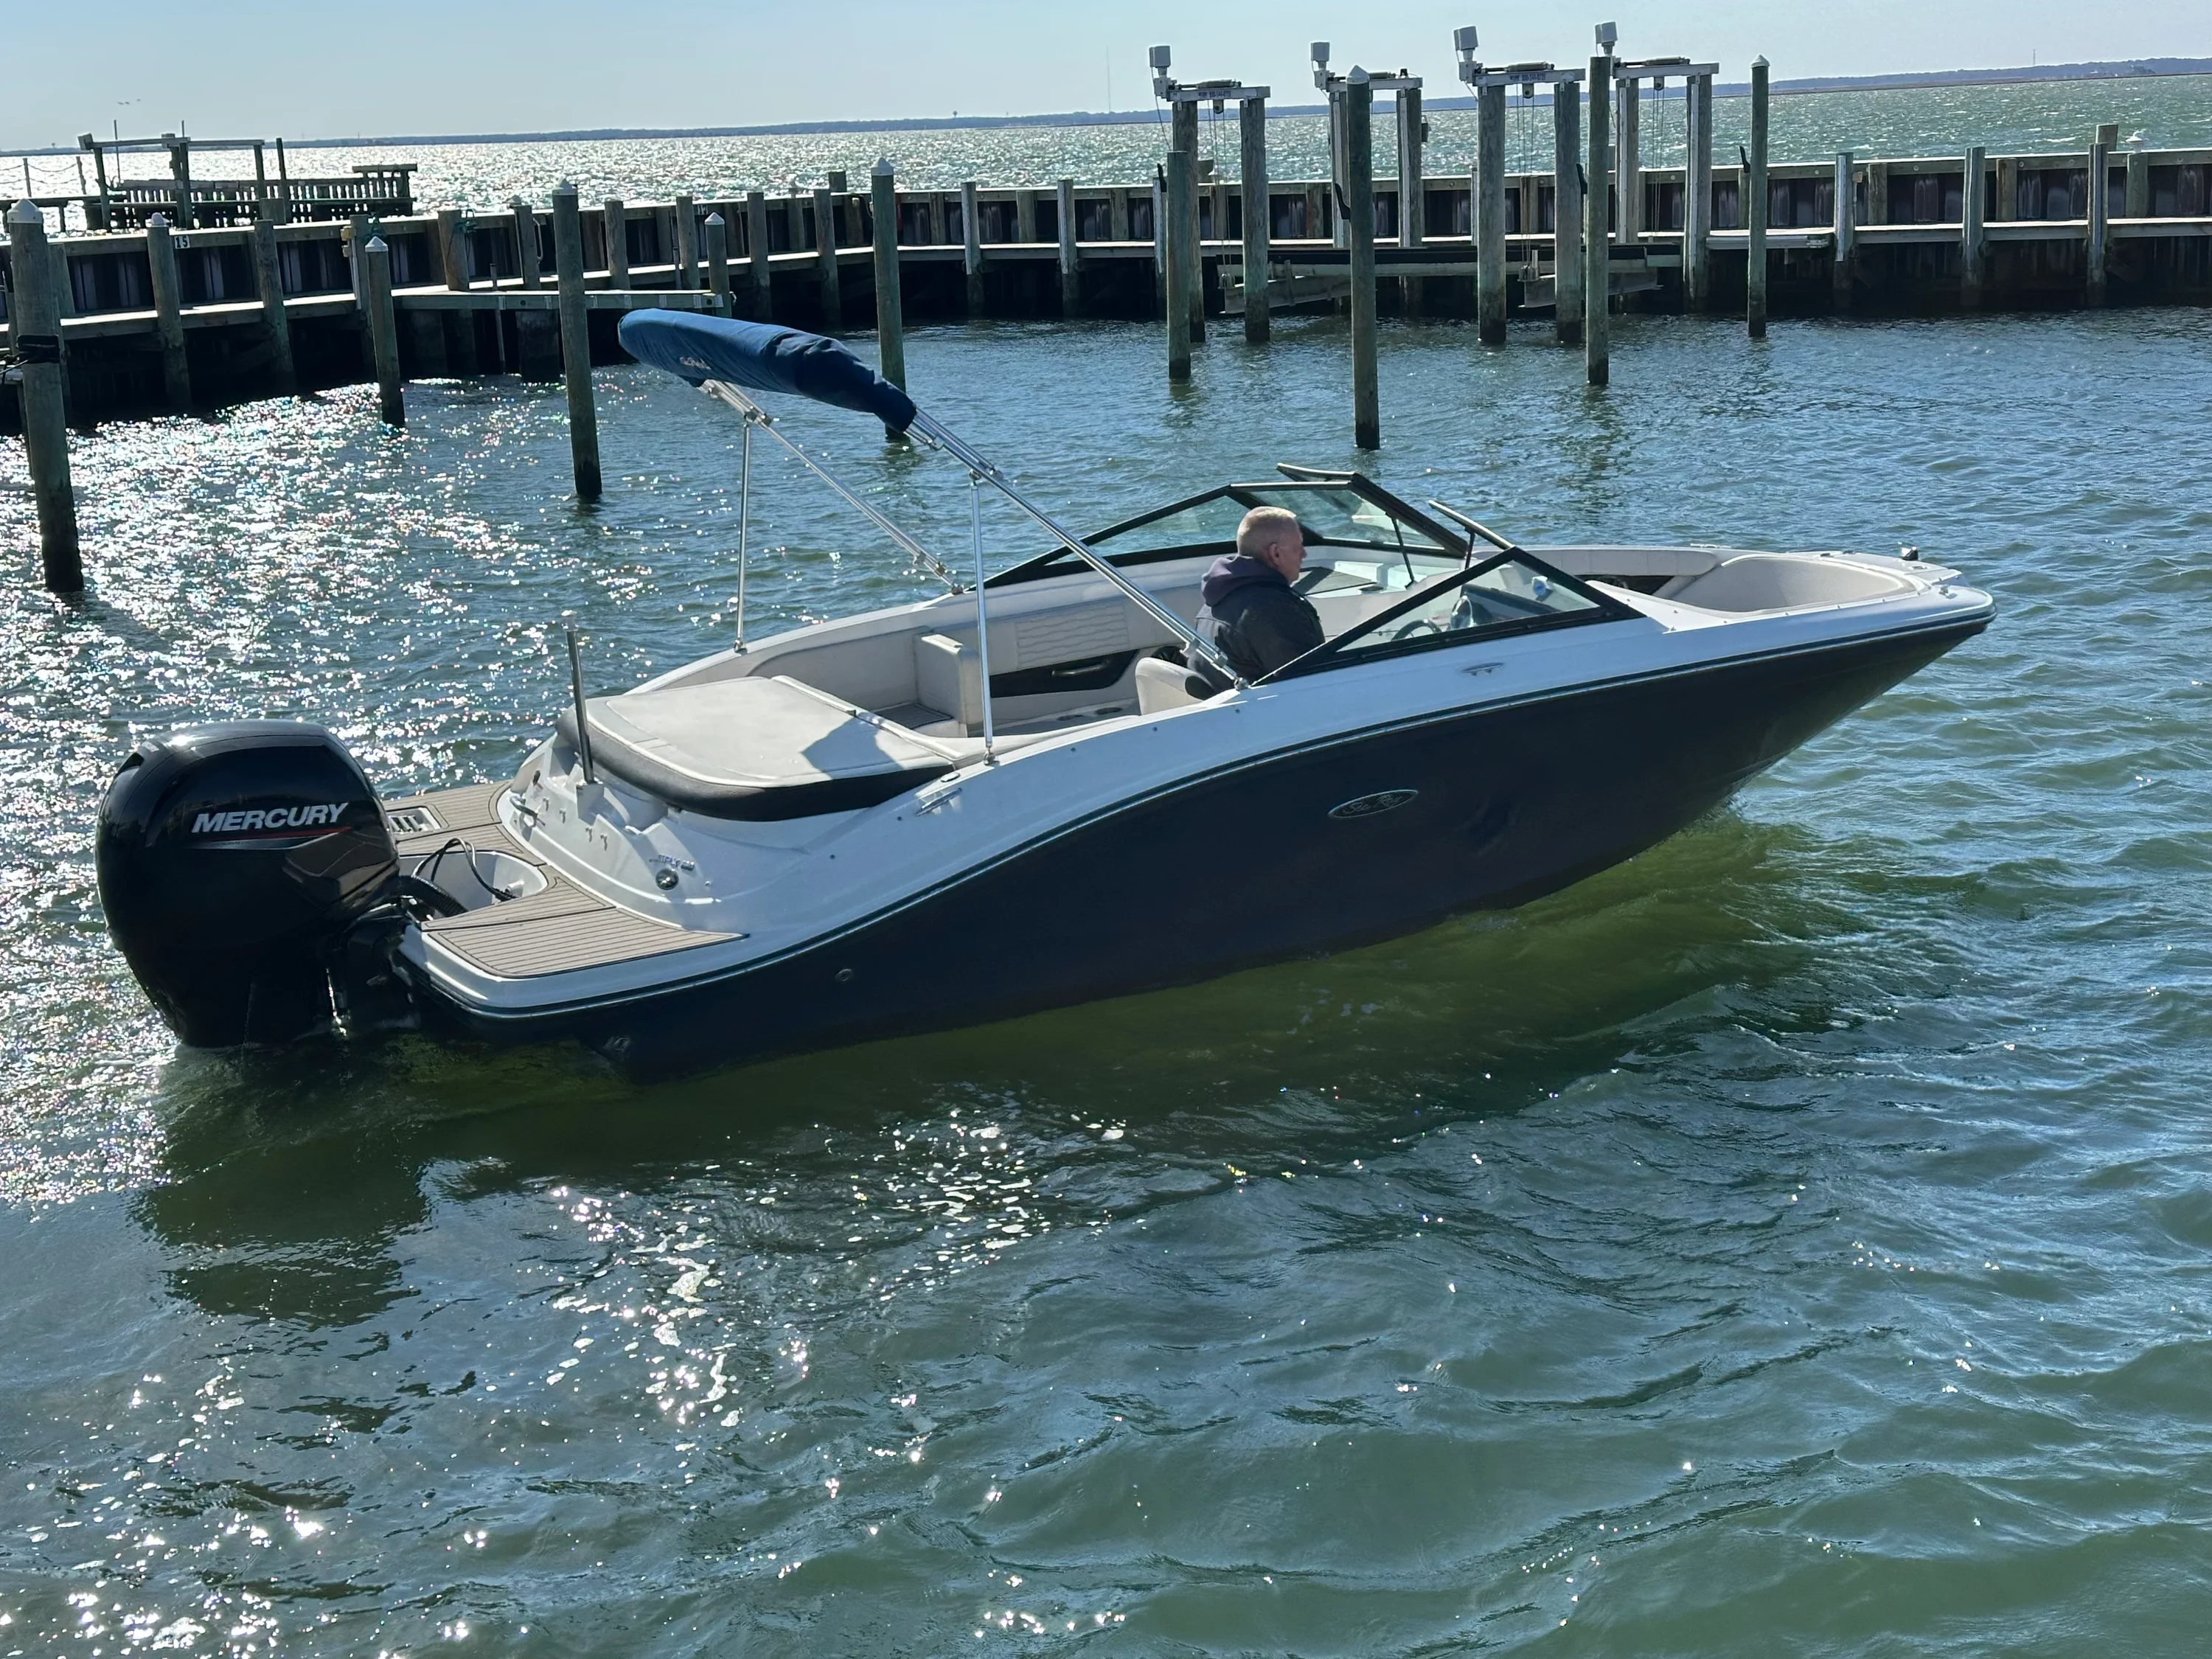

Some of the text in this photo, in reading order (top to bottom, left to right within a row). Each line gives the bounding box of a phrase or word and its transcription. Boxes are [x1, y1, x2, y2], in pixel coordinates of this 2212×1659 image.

[175, 236, 188, 248] 15
[1343, 794, 1402, 814] Sea Ray
[190, 802, 349, 834] MERCURY
